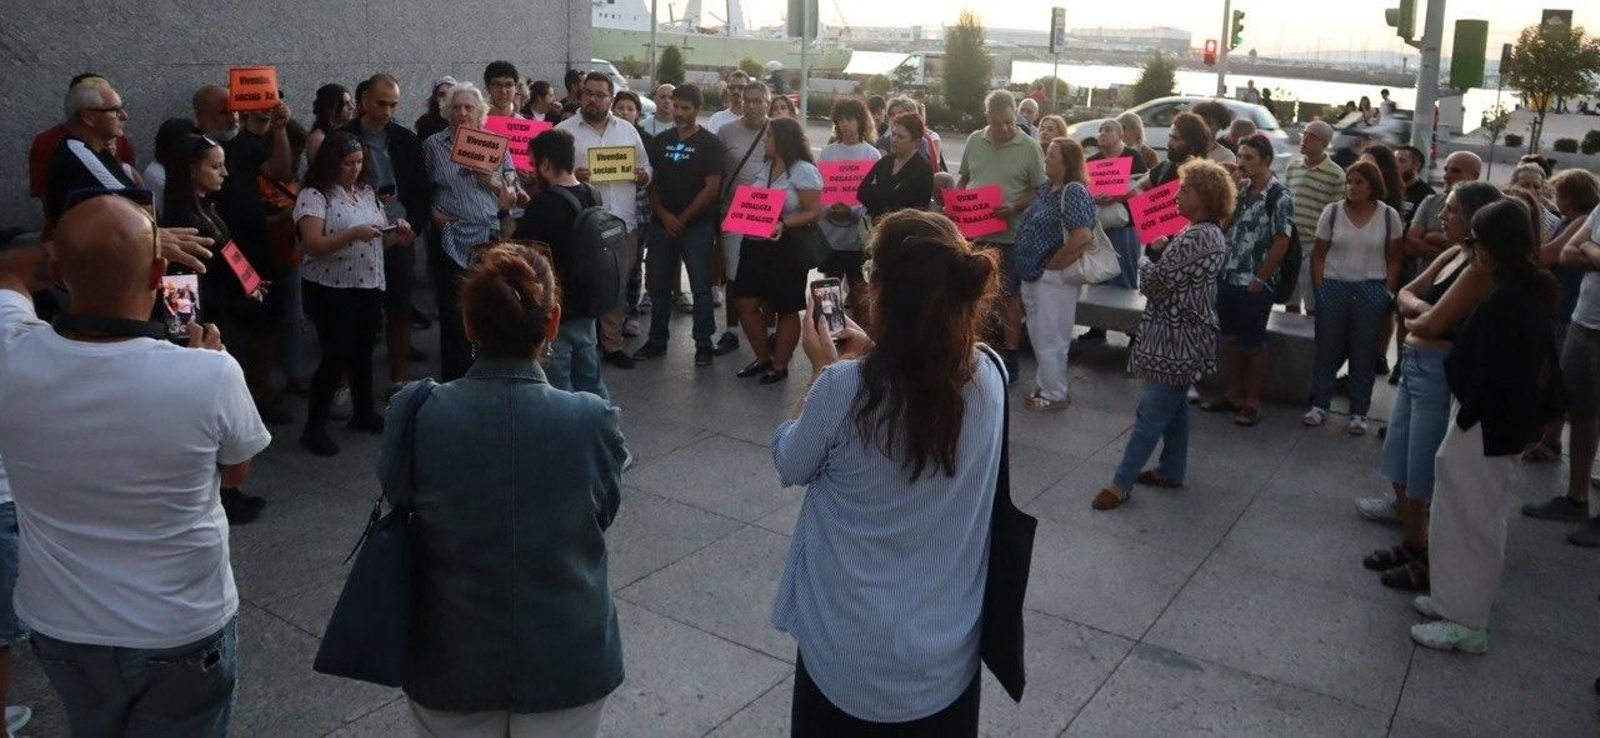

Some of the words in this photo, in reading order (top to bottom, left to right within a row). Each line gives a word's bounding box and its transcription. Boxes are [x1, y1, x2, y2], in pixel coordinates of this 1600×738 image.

[506, 122, 531, 132] QUEN
[466, 135, 500, 151] Vivendas
[456, 149, 486, 163] sociais
[596, 152, 628, 162] Vivendas
[592, 165, 617, 175] sociais
[620, 164, 632, 174] Xa!
[839, 164, 860, 172] QUEN
[751, 191, 770, 200] QUEN
[955, 193, 978, 203] QUEN
[1149, 188, 1171, 203] QUEN
[1140, 219, 1157, 231] QUE
